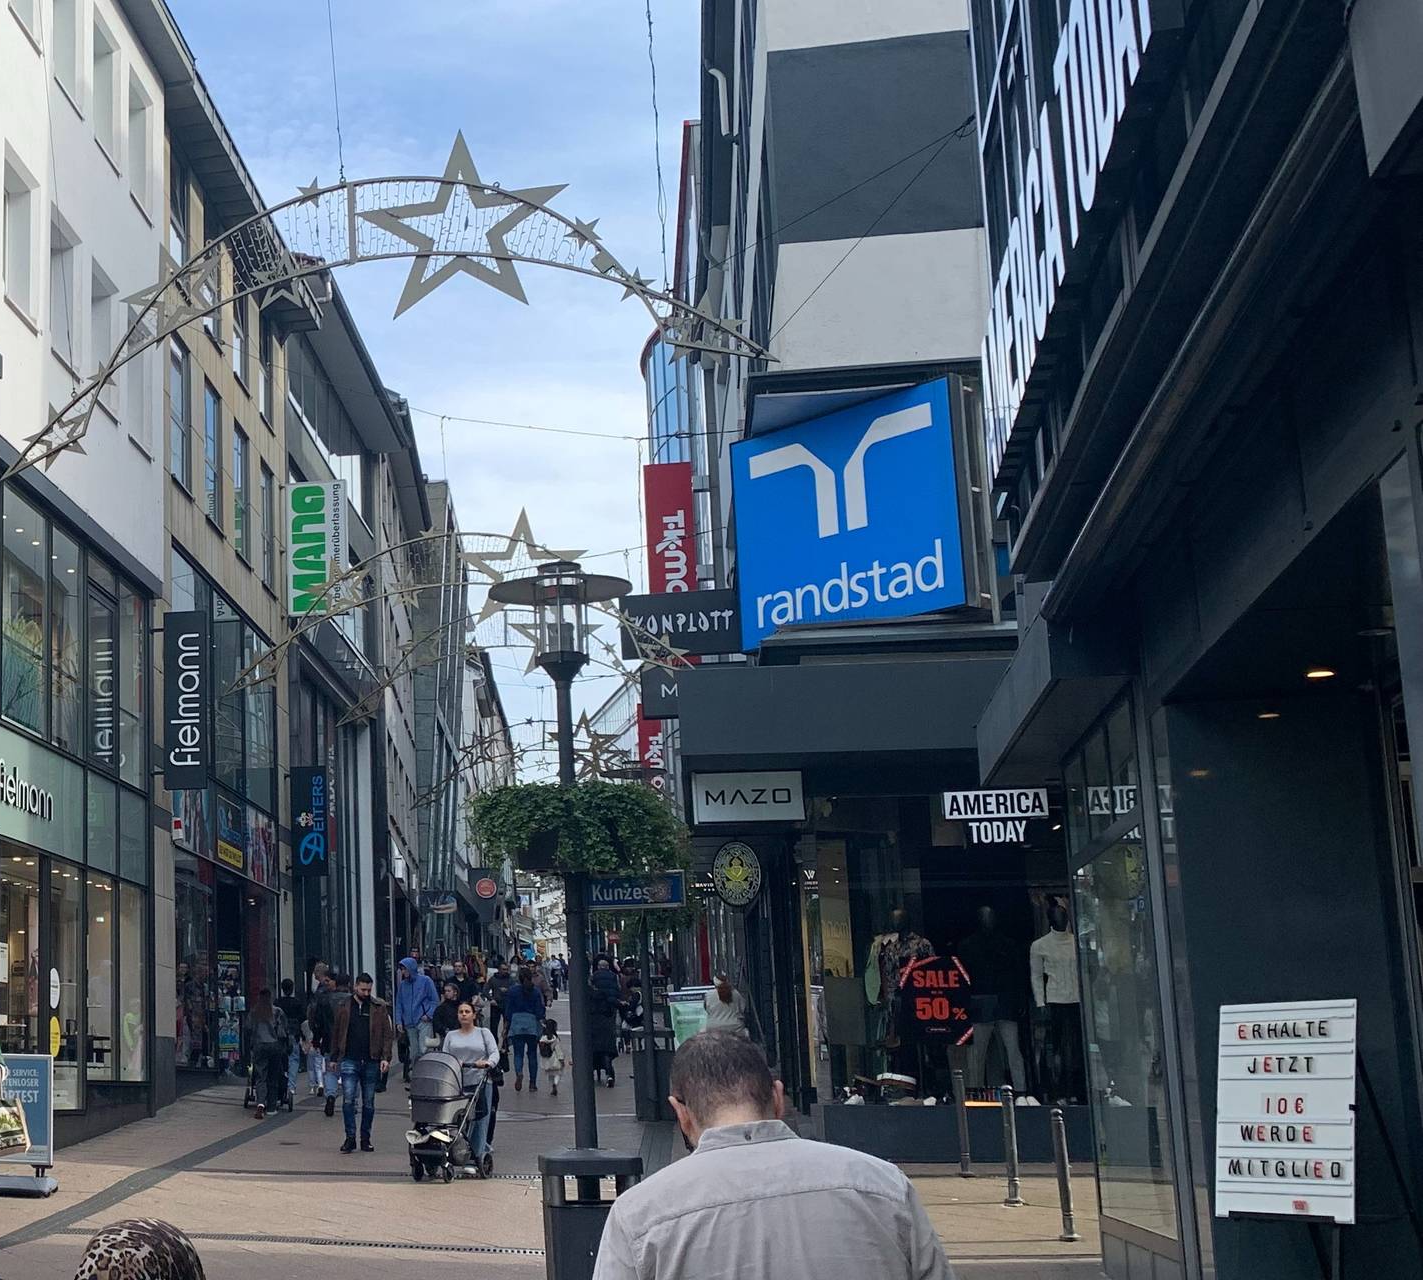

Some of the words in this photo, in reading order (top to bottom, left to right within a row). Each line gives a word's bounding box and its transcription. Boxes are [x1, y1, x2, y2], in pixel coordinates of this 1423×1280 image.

[981, 101, 1066, 494] AMERICA
[1052, 0, 1152, 248] TODA
[757, 538, 945, 628] randstad
[634, 609, 734, 635] KONPLOTT
[170, 632, 200, 766] fielmann
[705, 788, 791, 805] MAZO
[949, 792, 1045, 816] AMERICA
[300, 775, 324, 865] DEITERS
[968, 820, 1026, 843] TODAY
[912, 970, 960, 988] SALE
[1237, 1021, 1328, 1040] ERHALTE
[1248, 1057, 1313, 1073] JETZT
[1241, 1125, 1313, 1142] WERDE
[1228, 1159, 1341, 1178] MITGLIED
